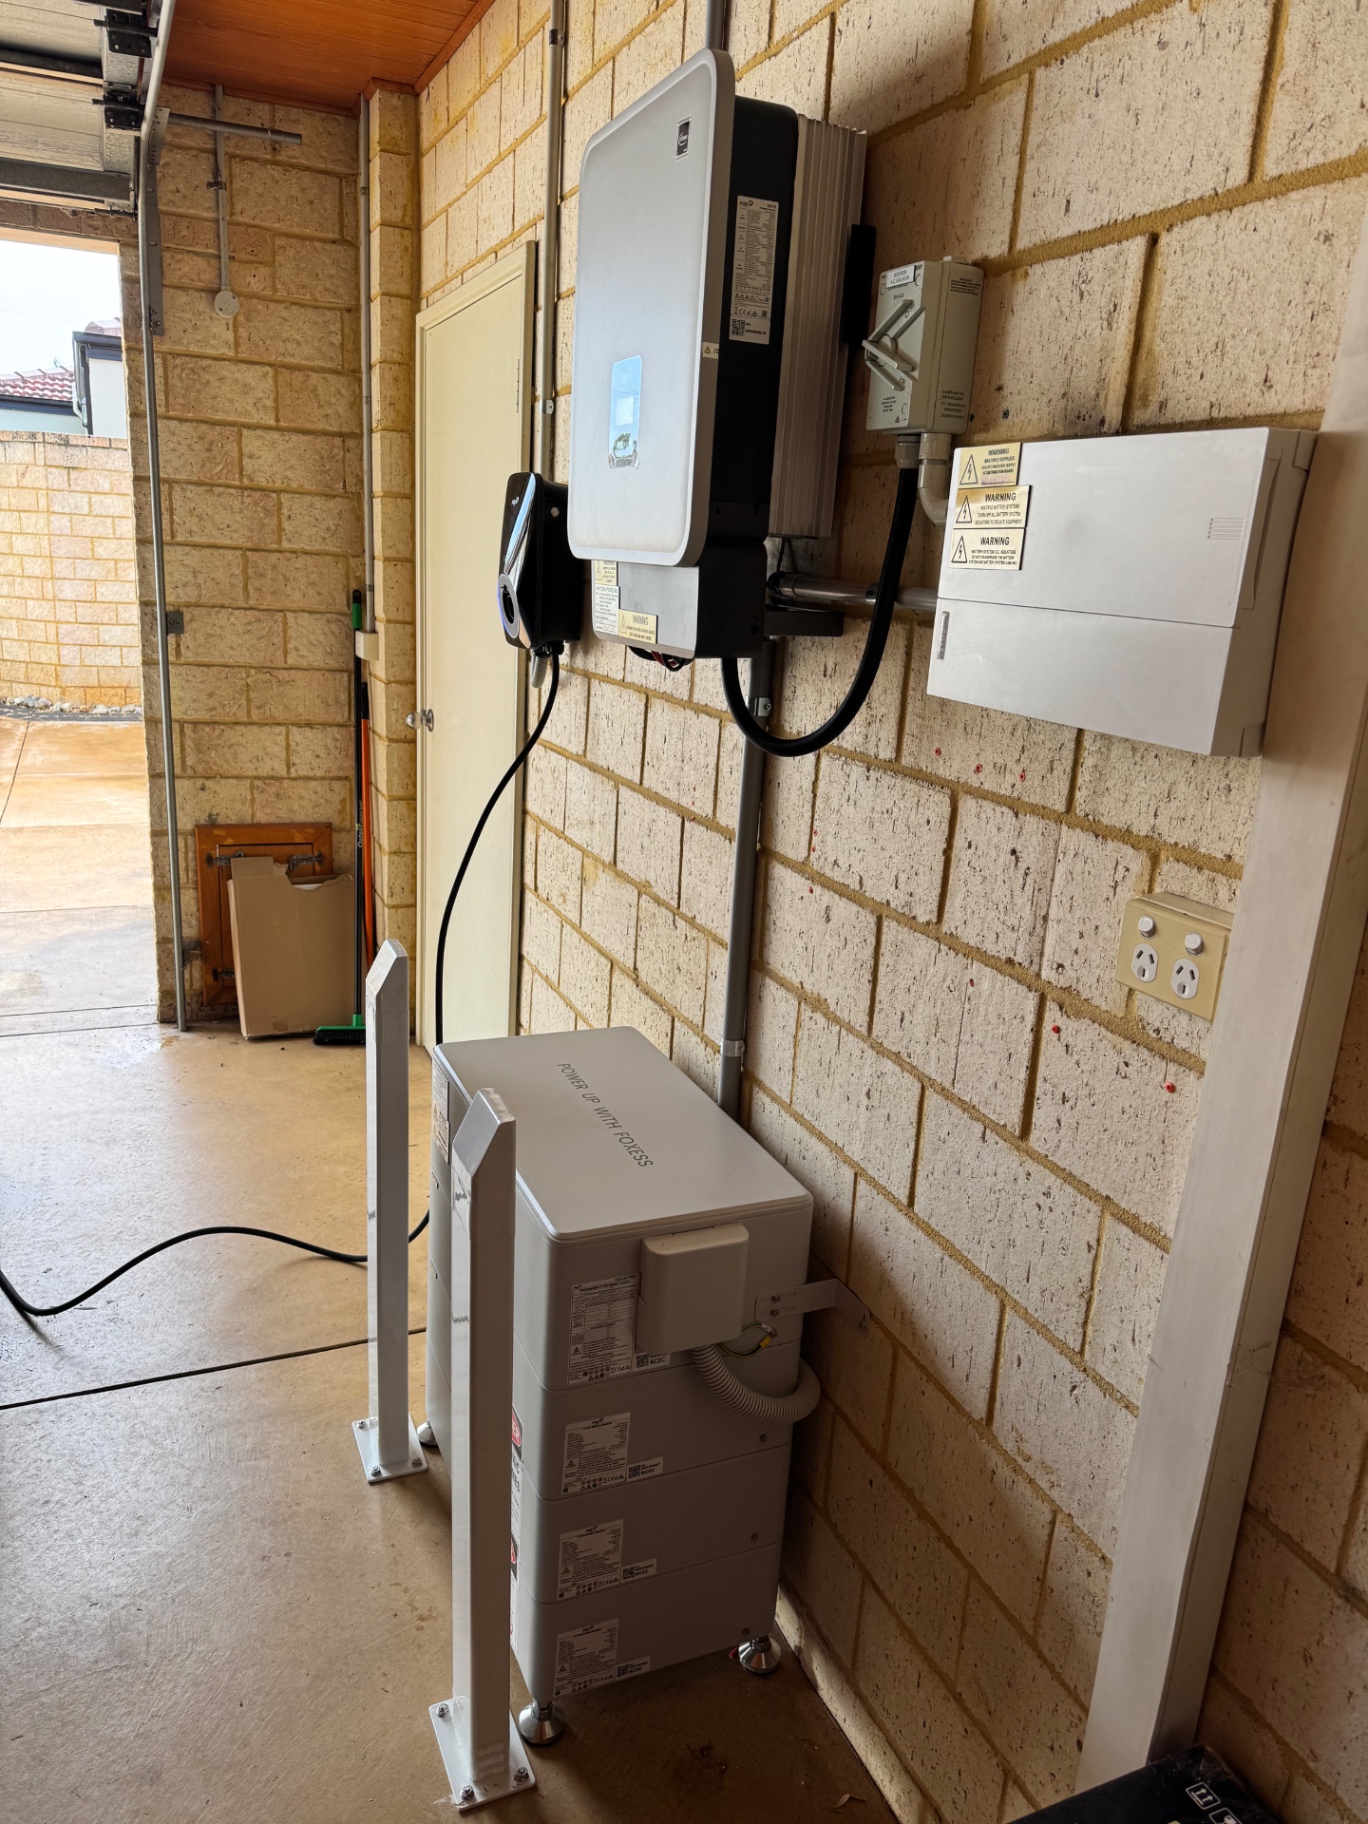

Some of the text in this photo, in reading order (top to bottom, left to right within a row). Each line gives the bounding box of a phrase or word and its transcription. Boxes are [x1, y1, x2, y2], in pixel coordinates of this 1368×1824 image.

[988, 447, 1010, 456] WARNING
[985, 492, 1017, 502] WARNING
[980, 536, 1010, 546] WARNING
[556, 1063, 654, 1168] POWER UP WITH FOXESS
